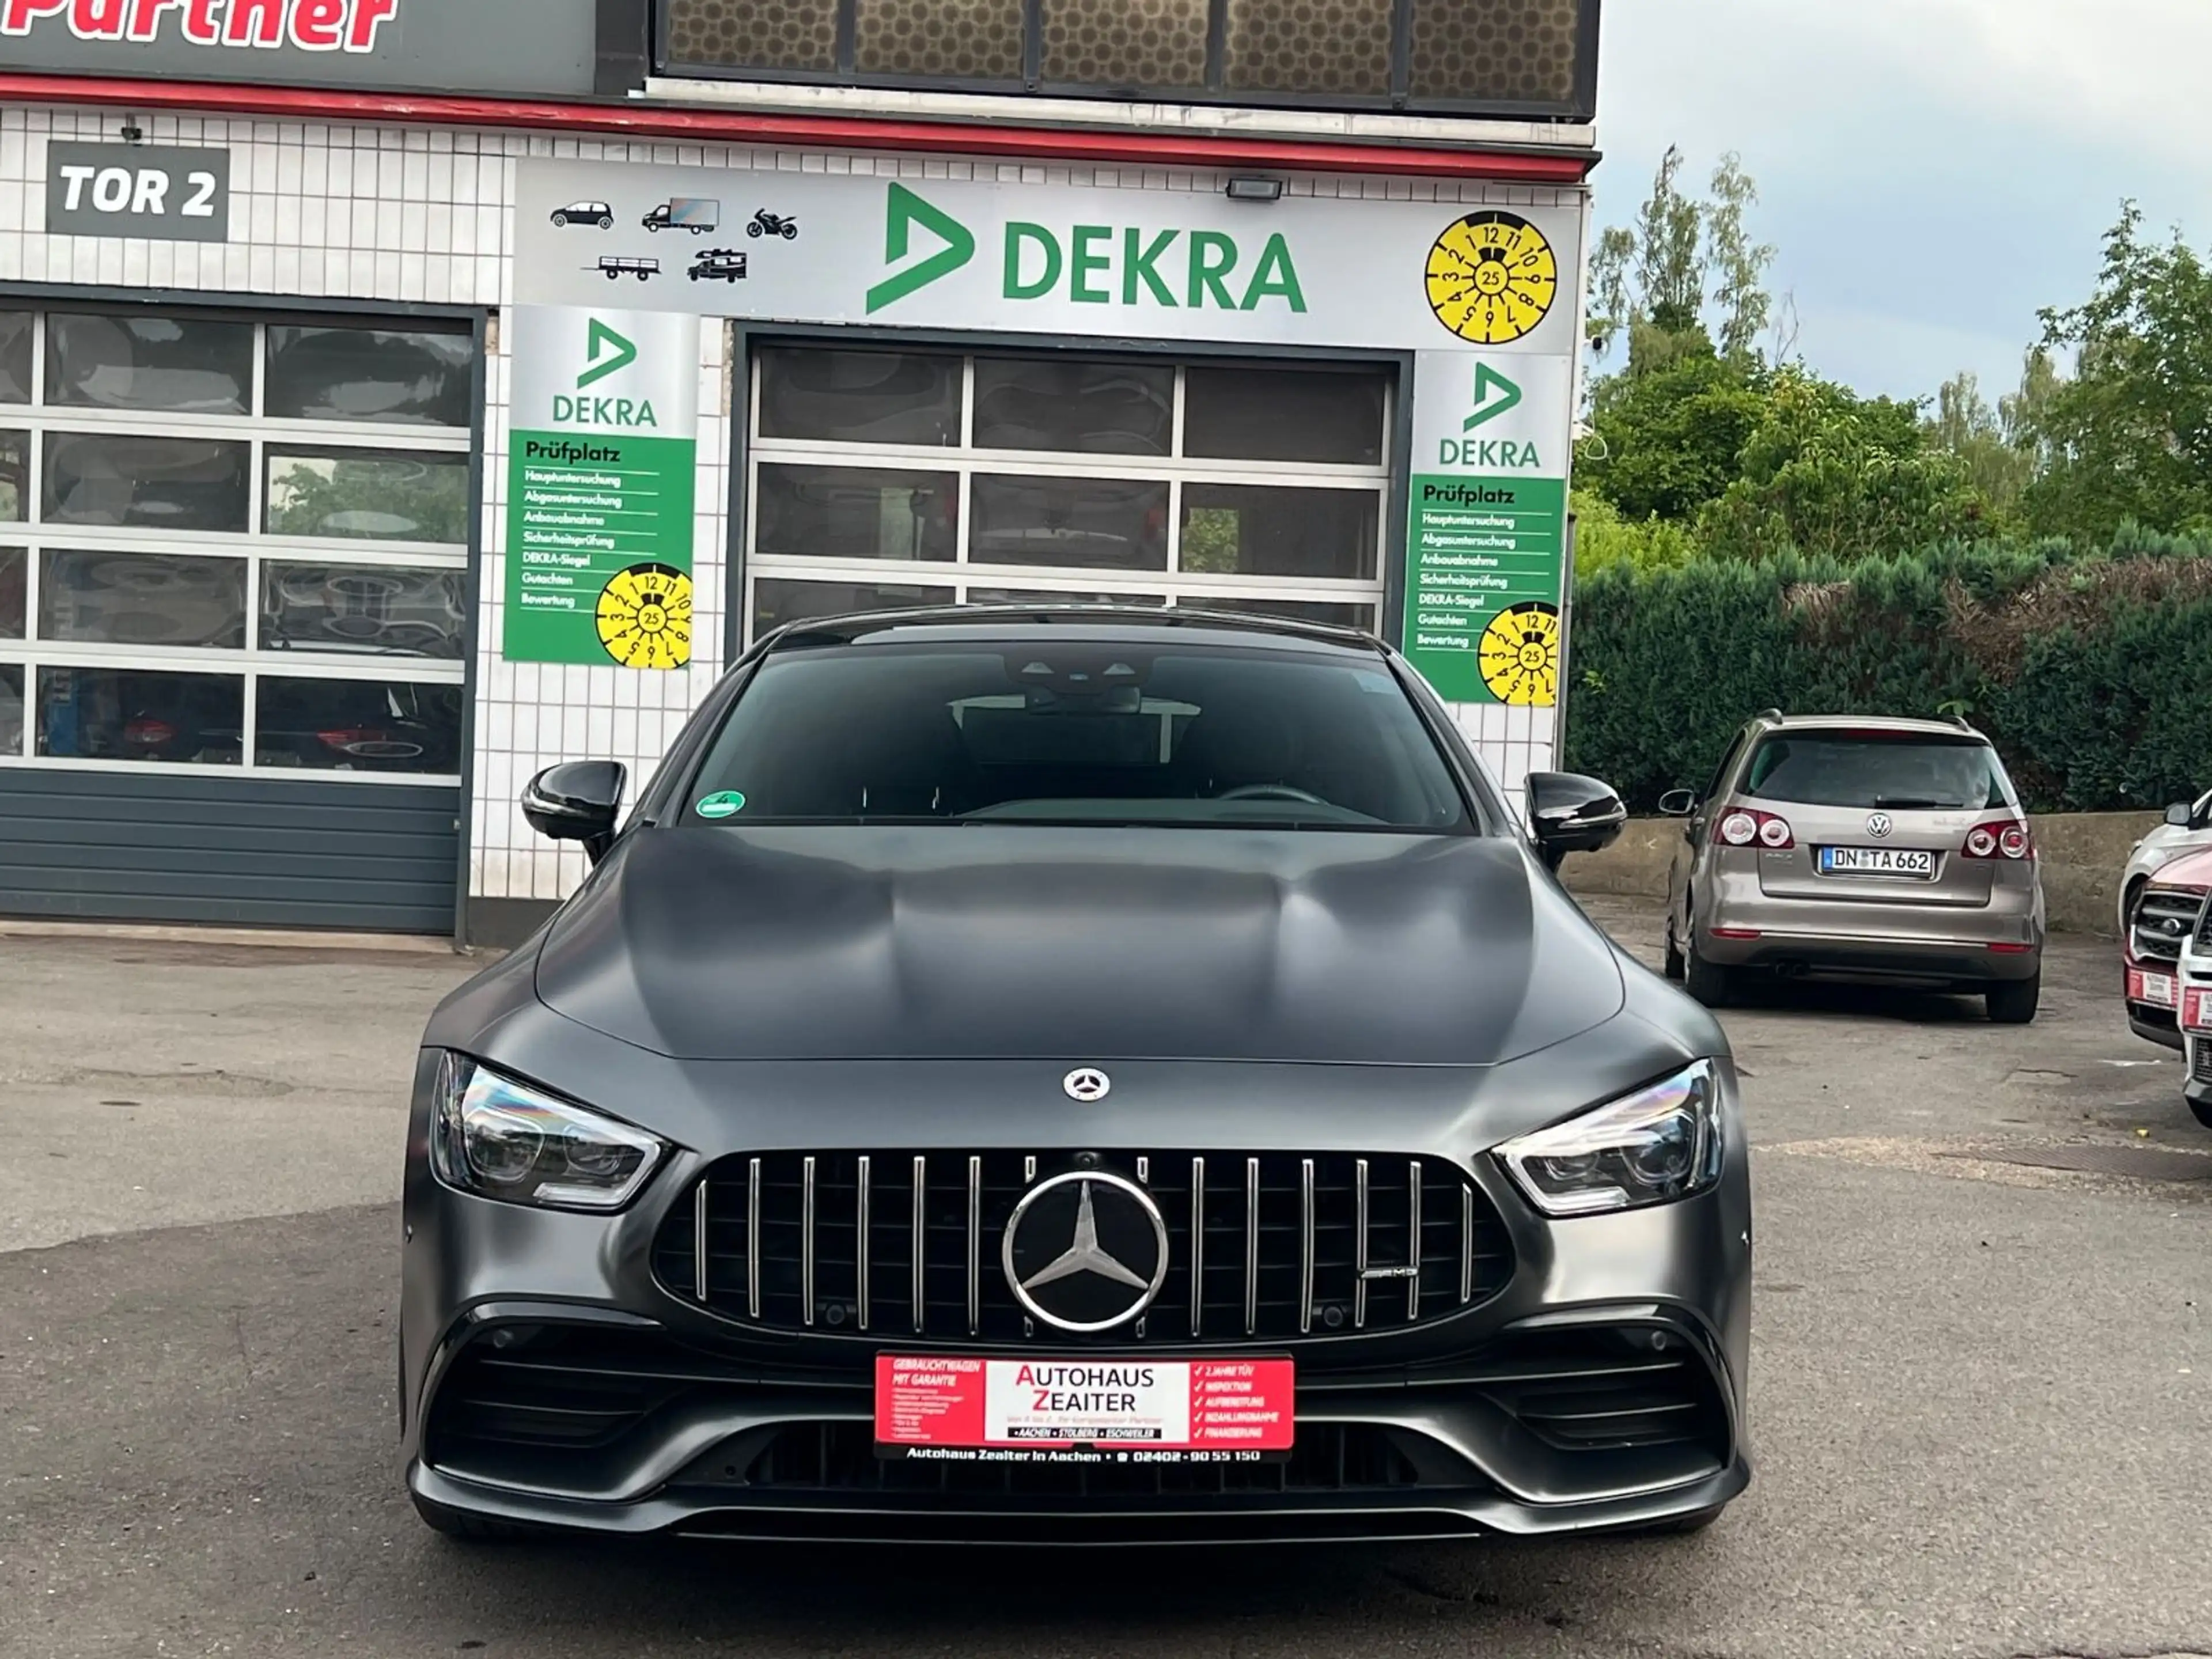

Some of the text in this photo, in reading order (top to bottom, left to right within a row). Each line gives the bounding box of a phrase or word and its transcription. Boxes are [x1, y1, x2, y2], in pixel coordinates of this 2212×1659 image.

[60, 166, 217, 217] TOR 2
[1465, 234, 1476, 250] 1
[1483, 227, 1499, 243] 12
[1506, 231, 1521, 250] 11
[1448, 249, 1465, 264] 2
[1520, 248, 1539, 267] 10
[1003, 222, 1307, 313] DEKRA
[1442, 272, 1459, 282] 3
[1482, 271, 1499, 286] 25
[1447, 291, 1462, 302] 4
[1518, 293, 1535, 306] 8
[1462, 306, 1477, 323] 5
[1508, 306, 1516, 323] 7
[553, 395, 657, 427] DEKRA
[526, 441, 620, 464] Prüfplatz
[1440, 438, 1540, 468] DEKRA
[525, 470, 621, 488] Hauptuntersuchung
[524, 490, 622, 509] Abgasuntersuchung
[1423, 484, 1514, 507] Prüfplatz
[524, 510, 605, 525] Anbauabnahme
[1422, 513, 1515, 530] Hauptuntersuchung
[523, 531, 615, 550] Sicherheitsprüfung
[1421, 532, 1516, 550] Abgasuntersuchung
[522, 551, 590, 567] DEKRA-Siegel
[1421, 552, 1498, 567] Anbauabnahme
[522, 572, 573, 585] Gutachten
[645, 576, 658, 590] 12
[1419, 573, 1508, 590] Sicherheitsprüfung
[629, 582, 639, 595] 1
[664, 579, 678, 596] 11
[521, 592, 575, 609] Bewertung
[615, 593, 630, 607] 2
[675, 593, 691, 609] 10
[1418, 593, 1484, 609] DEKRA-Siegel
[609, 613, 625, 622] 3
[644, 612, 660, 625] 25
[1418, 613, 1467, 626] Gutachten
[1526, 615, 1539, 628] 12
[614, 630, 628, 638] 4
[1511, 620, 1520, 634] 1
[1544, 618, 1556, 634] 11
[675, 631, 689, 642] 8
[1417, 633, 1469, 649] Bewertung
[1497, 632, 1511, 645] 2
[628, 641, 640, 655] 5
[666, 642, 674, 656] 7
[1491, 652, 1506, 660] 3
[1525, 651, 1539, 663] 25
[1496, 668, 1509, 676] 4
[1509, 679, 1521, 692] 5
[1835, 850, 1928, 869] DN TA 662
[893, 1358, 980, 1373] GEBRAUCHTWAGEN
[1238, 1363, 1255, 1376] TÜV
[892, 1374, 956, 1387] MIT GARANTIE
[1016, 1365, 1154, 1387] AUTOHAUS
[1033, 1389, 1136, 1412] ZEAITER
[907, 1447, 976, 1460] Autohaus
[1048, 1450, 1101, 1462] Aachen
[1133, 1451, 1181, 1463] 02402
[1190, 1451, 1210, 1462] 90
[1211, 1450, 1231, 1461] 55
[1235, 1450, 1261, 1461] 150
